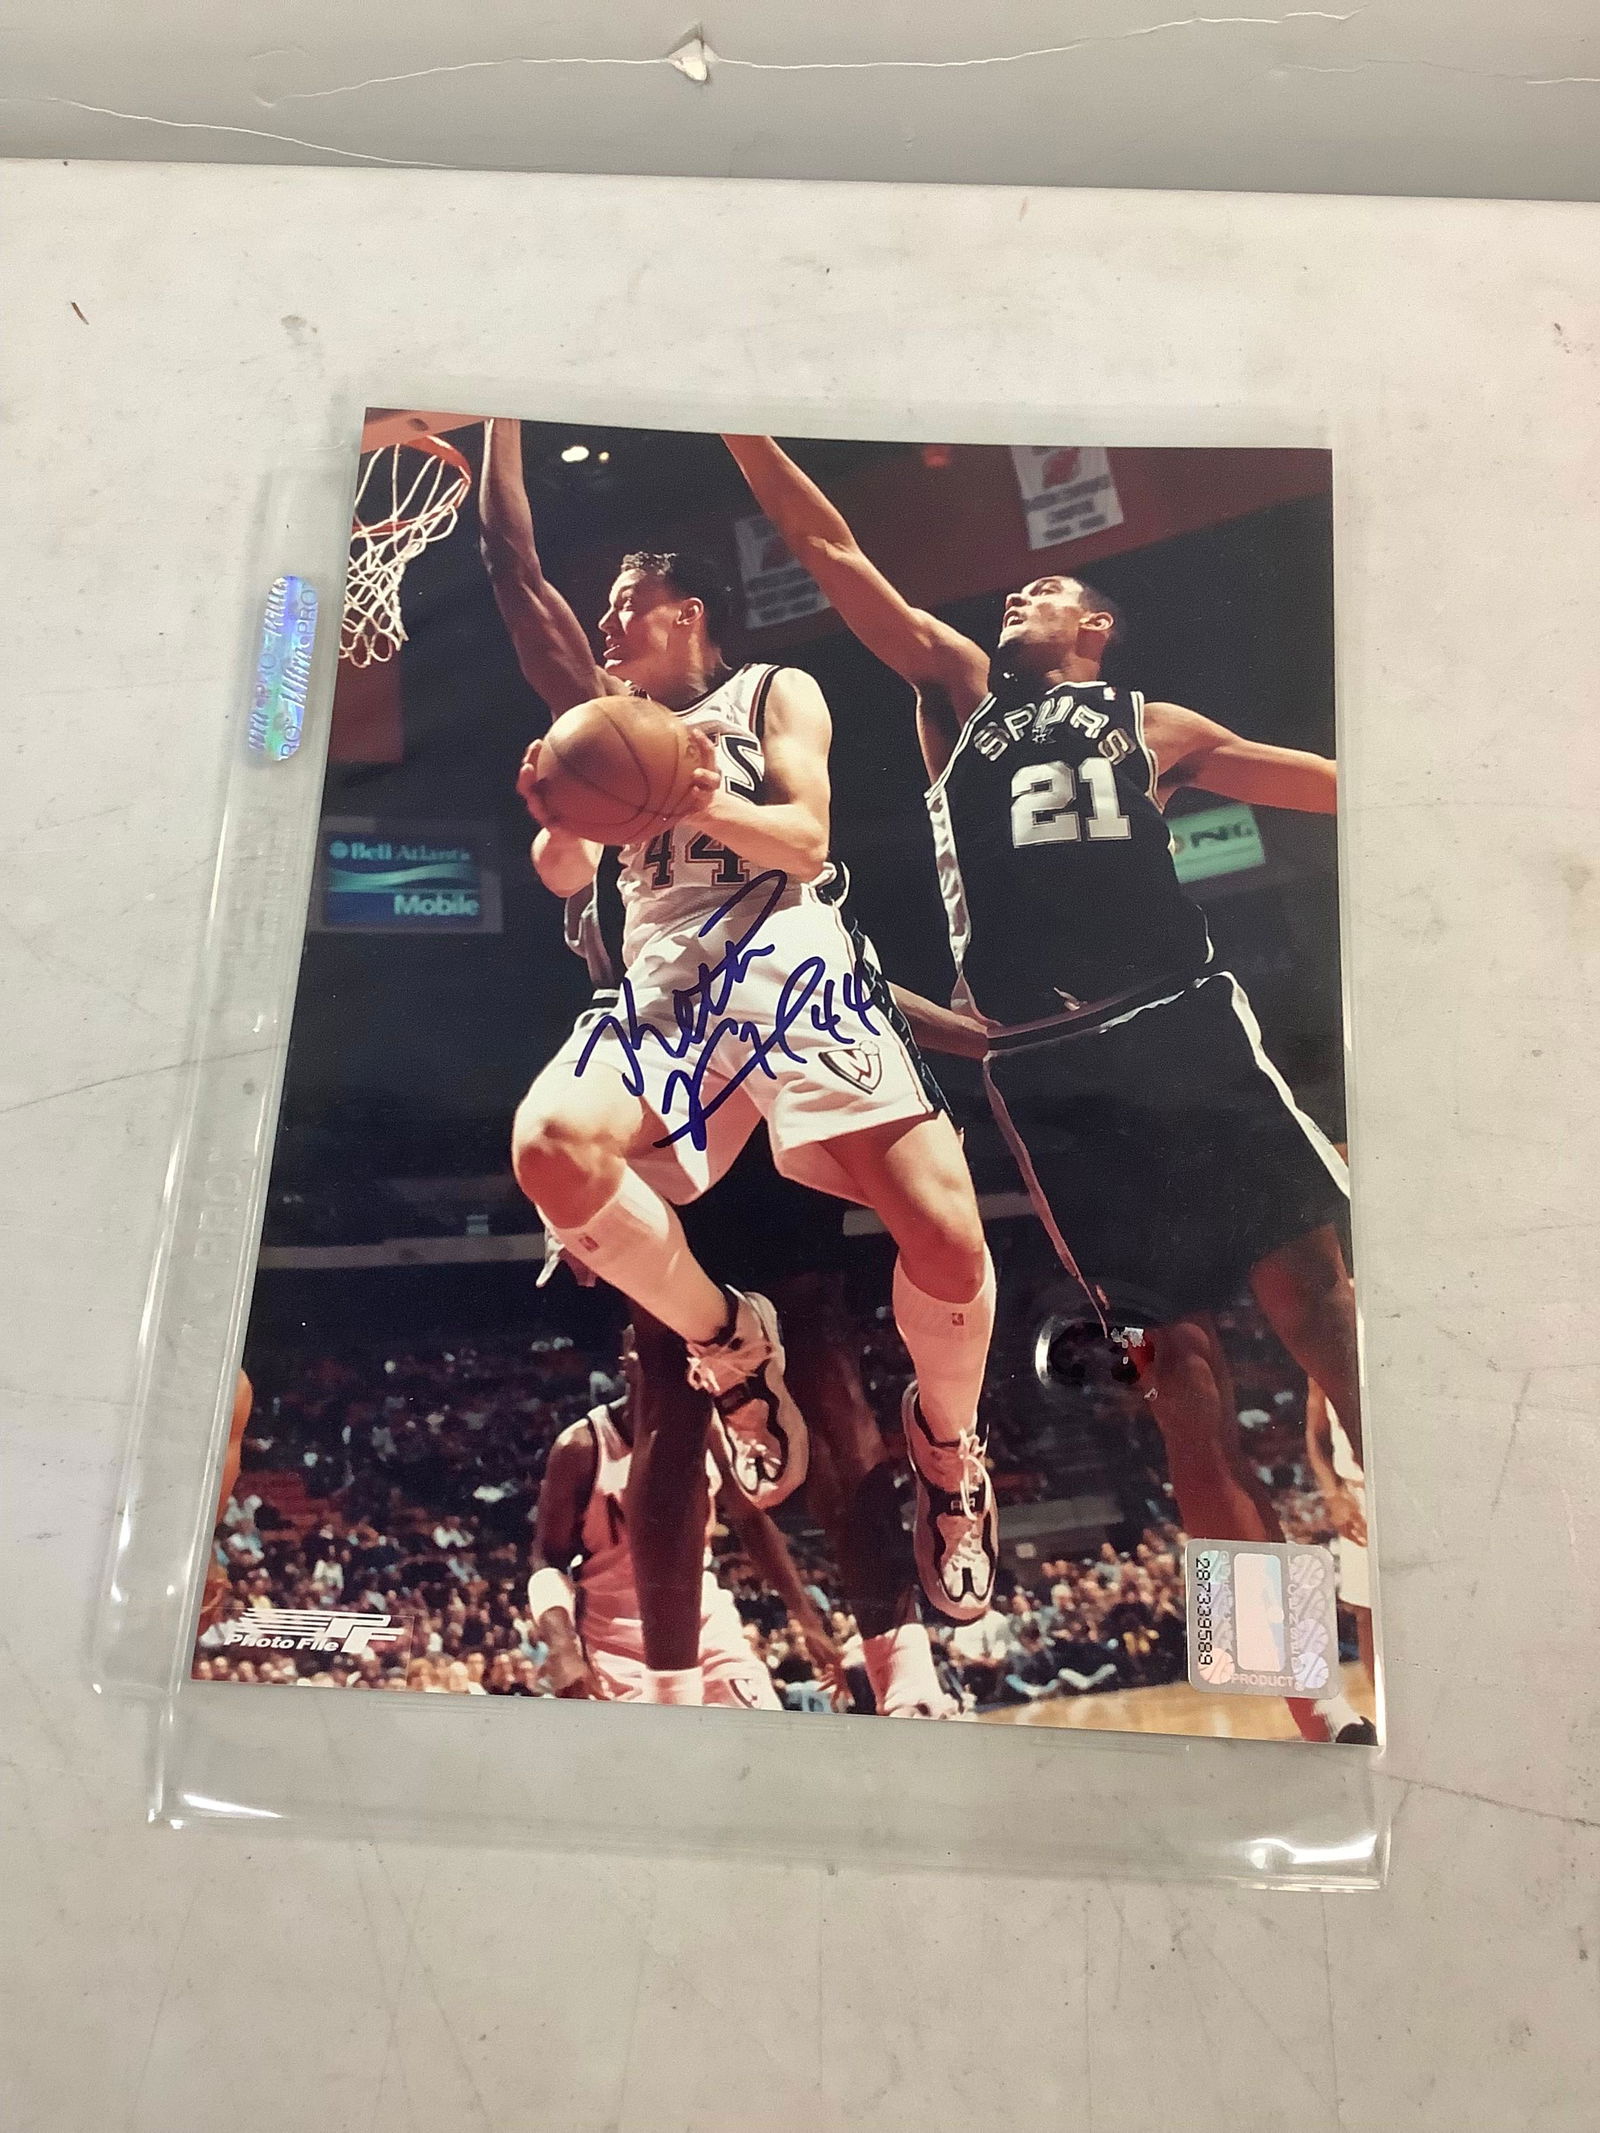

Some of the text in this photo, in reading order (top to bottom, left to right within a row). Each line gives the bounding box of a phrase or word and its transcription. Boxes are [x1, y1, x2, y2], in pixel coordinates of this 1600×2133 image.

[974, 695, 1136, 766] SPURS
[1011, 757, 1132, 848] 21
[643, 828, 751, 890] 44
[393, 891, 479, 917] Mobile
[811, 957, 881, 1044] 44
[223, 1634, 340, 1652] Photo File
[1195, 1556, 1213, 1666] 287339589
[1230, 1672, 1294, 1688] PRODUCT
